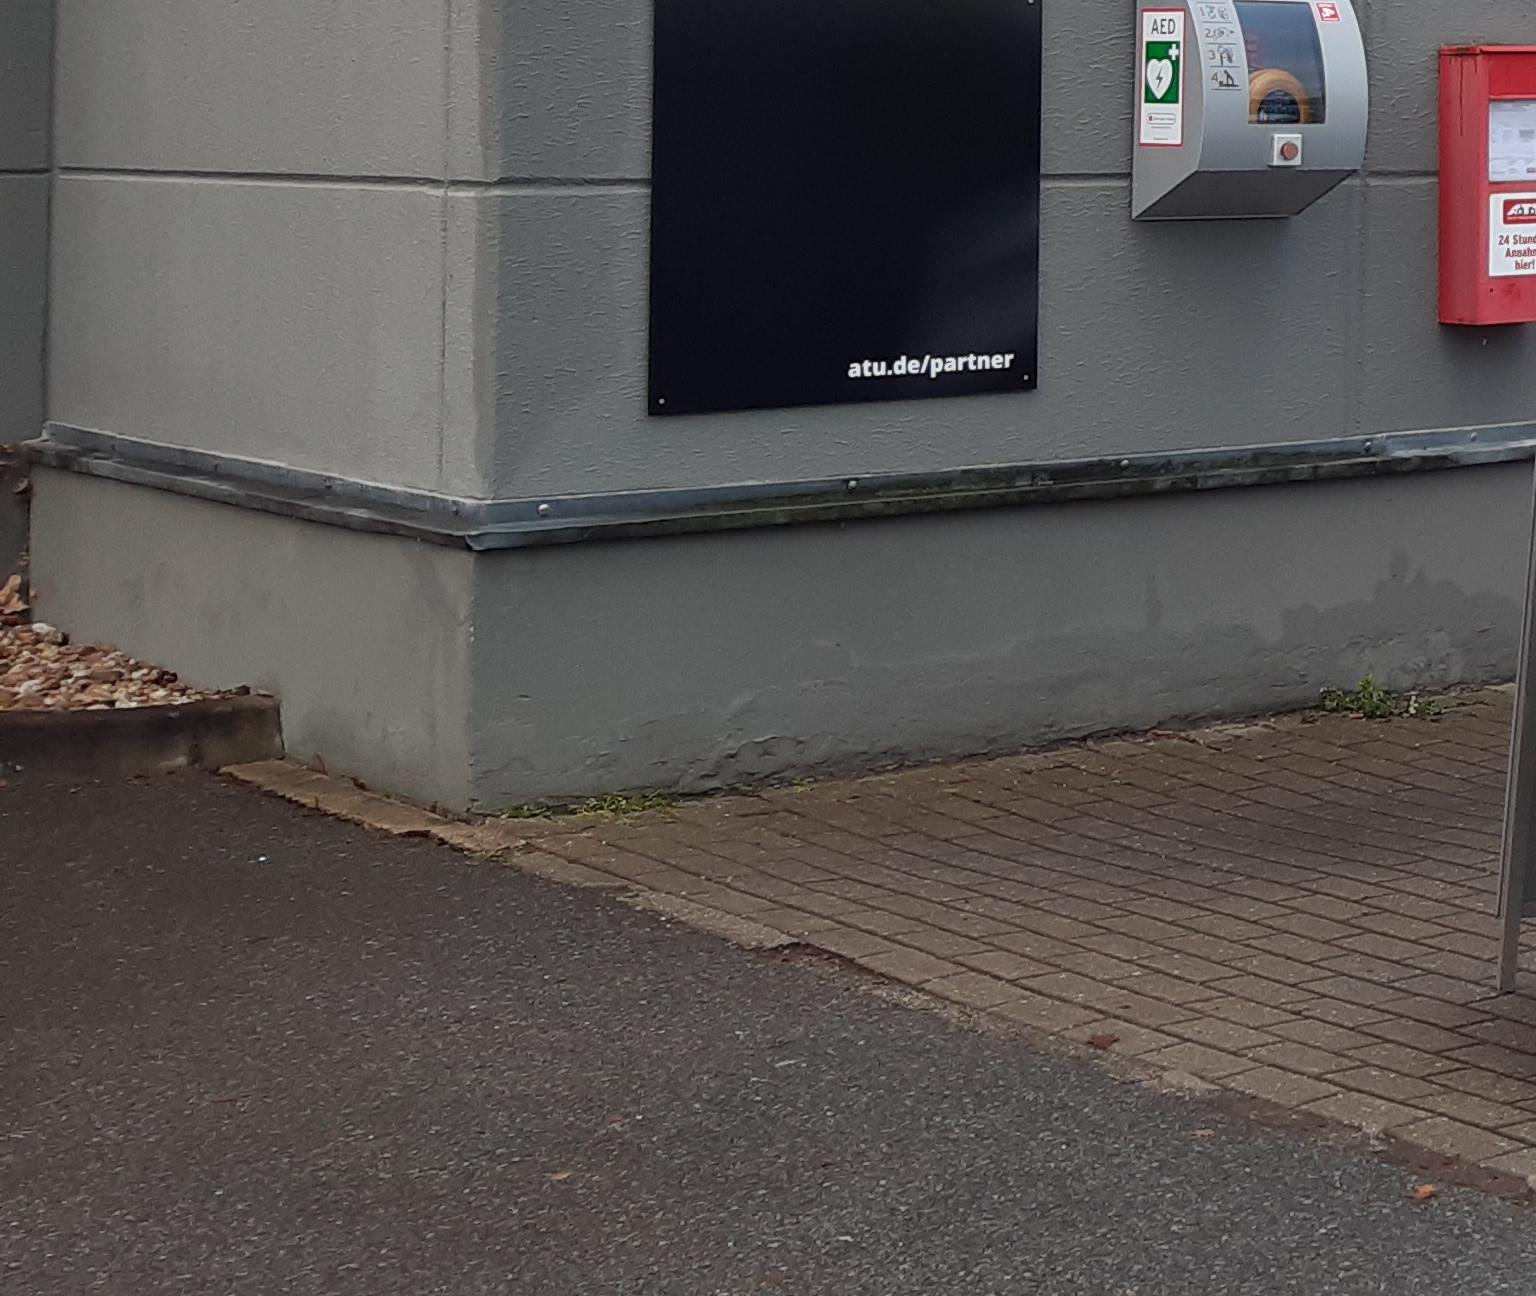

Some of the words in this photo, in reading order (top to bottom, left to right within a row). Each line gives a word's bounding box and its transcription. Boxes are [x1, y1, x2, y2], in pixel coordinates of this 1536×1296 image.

[1151, 18, 1176, 35] AED
[1498, 234, 1510, 245] 24
[847, 351, 1015, 379] atu.de/partner
